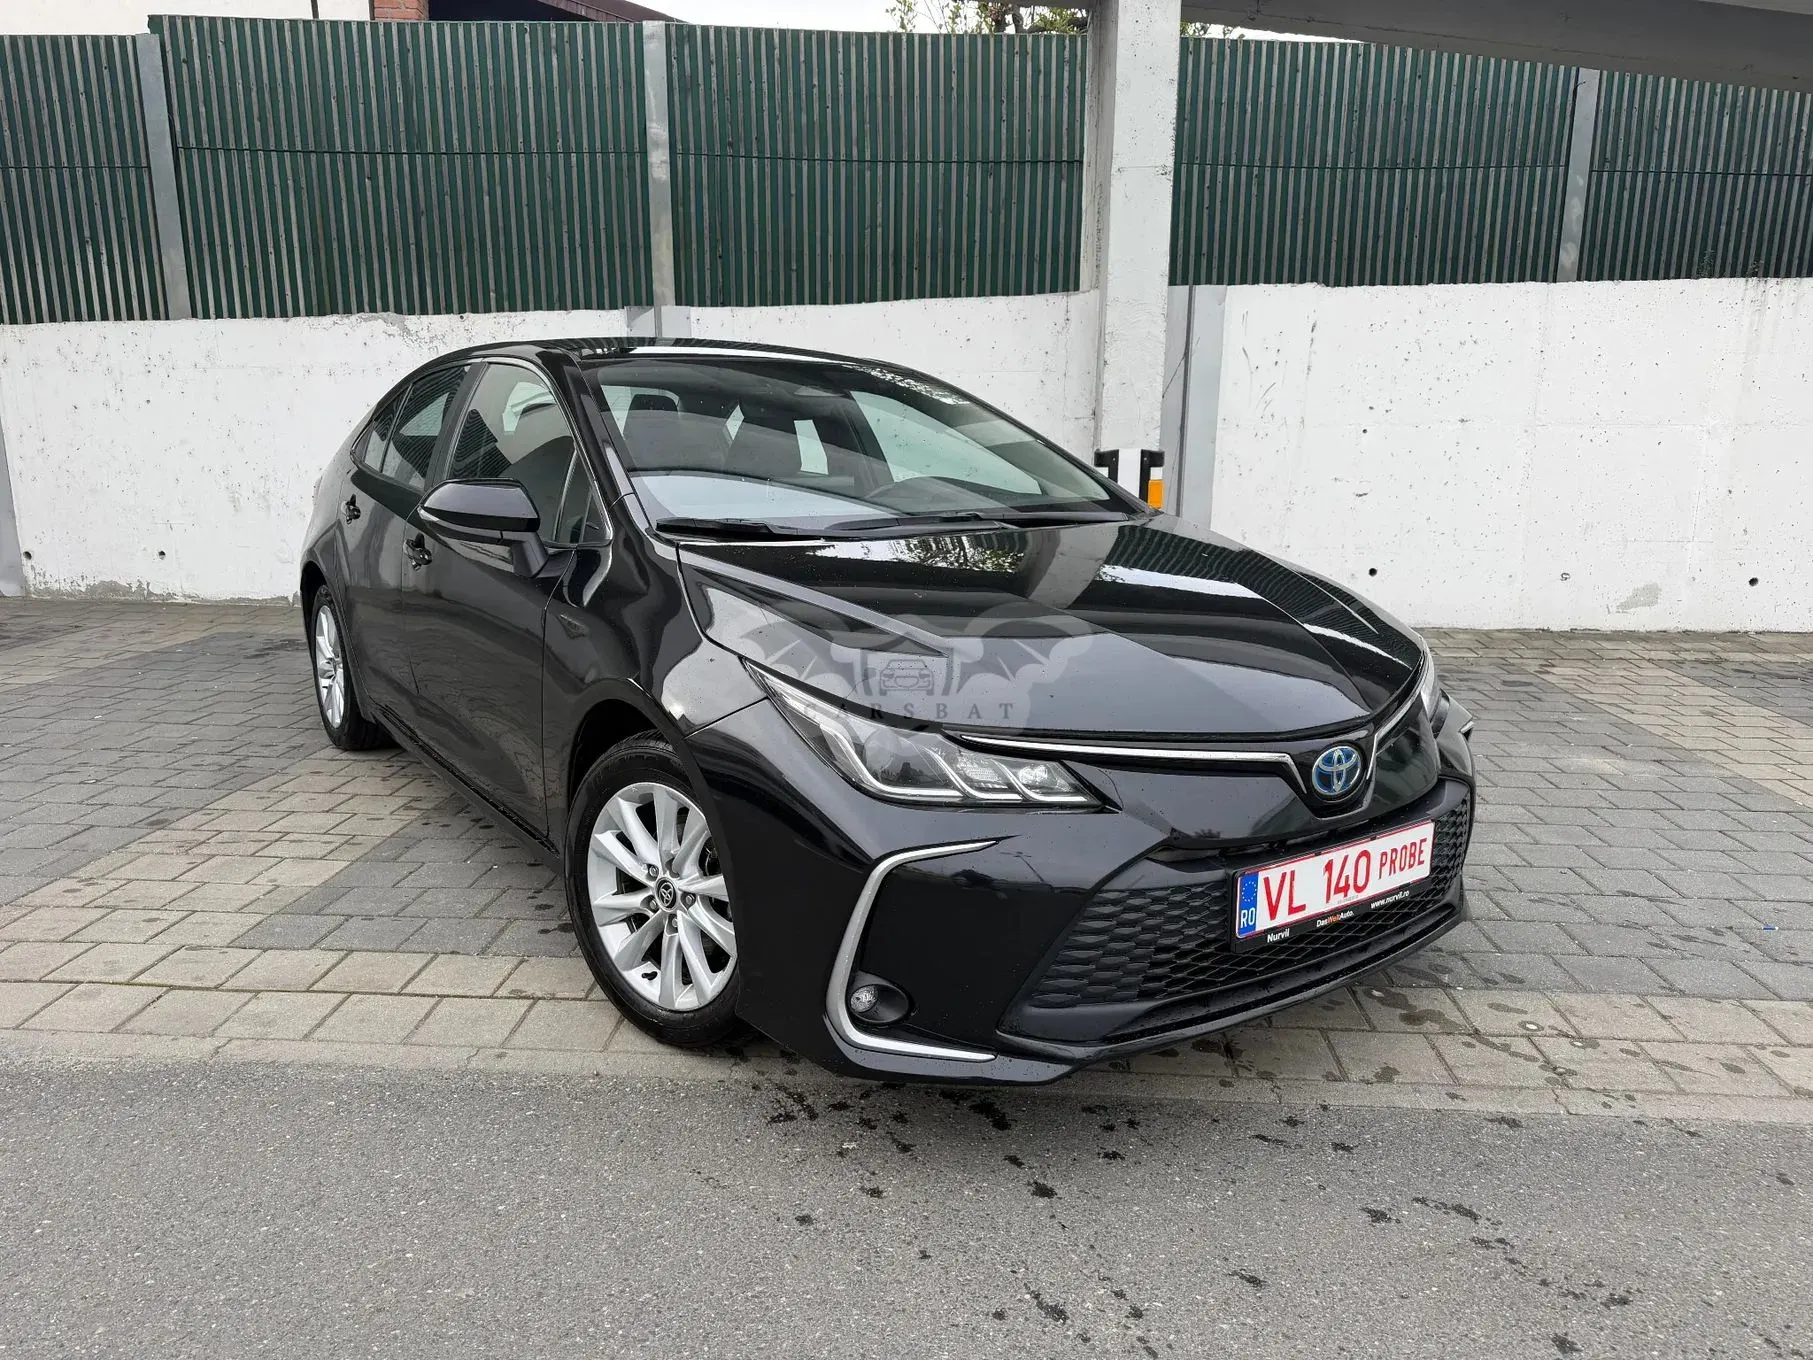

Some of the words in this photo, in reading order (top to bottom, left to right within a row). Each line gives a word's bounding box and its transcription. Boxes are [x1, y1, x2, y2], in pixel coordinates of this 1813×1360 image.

[1263, 870, 1307, 921] VL
[1323, 849, 1372, 904] 140
[1378, 838, 1428, 880] PROBE
[1240, 907, 1256, 929] RO
[1267, 928, 1290, 943] Nurvil
[1370, 890, 1410, 909] www.nurvil.ro
